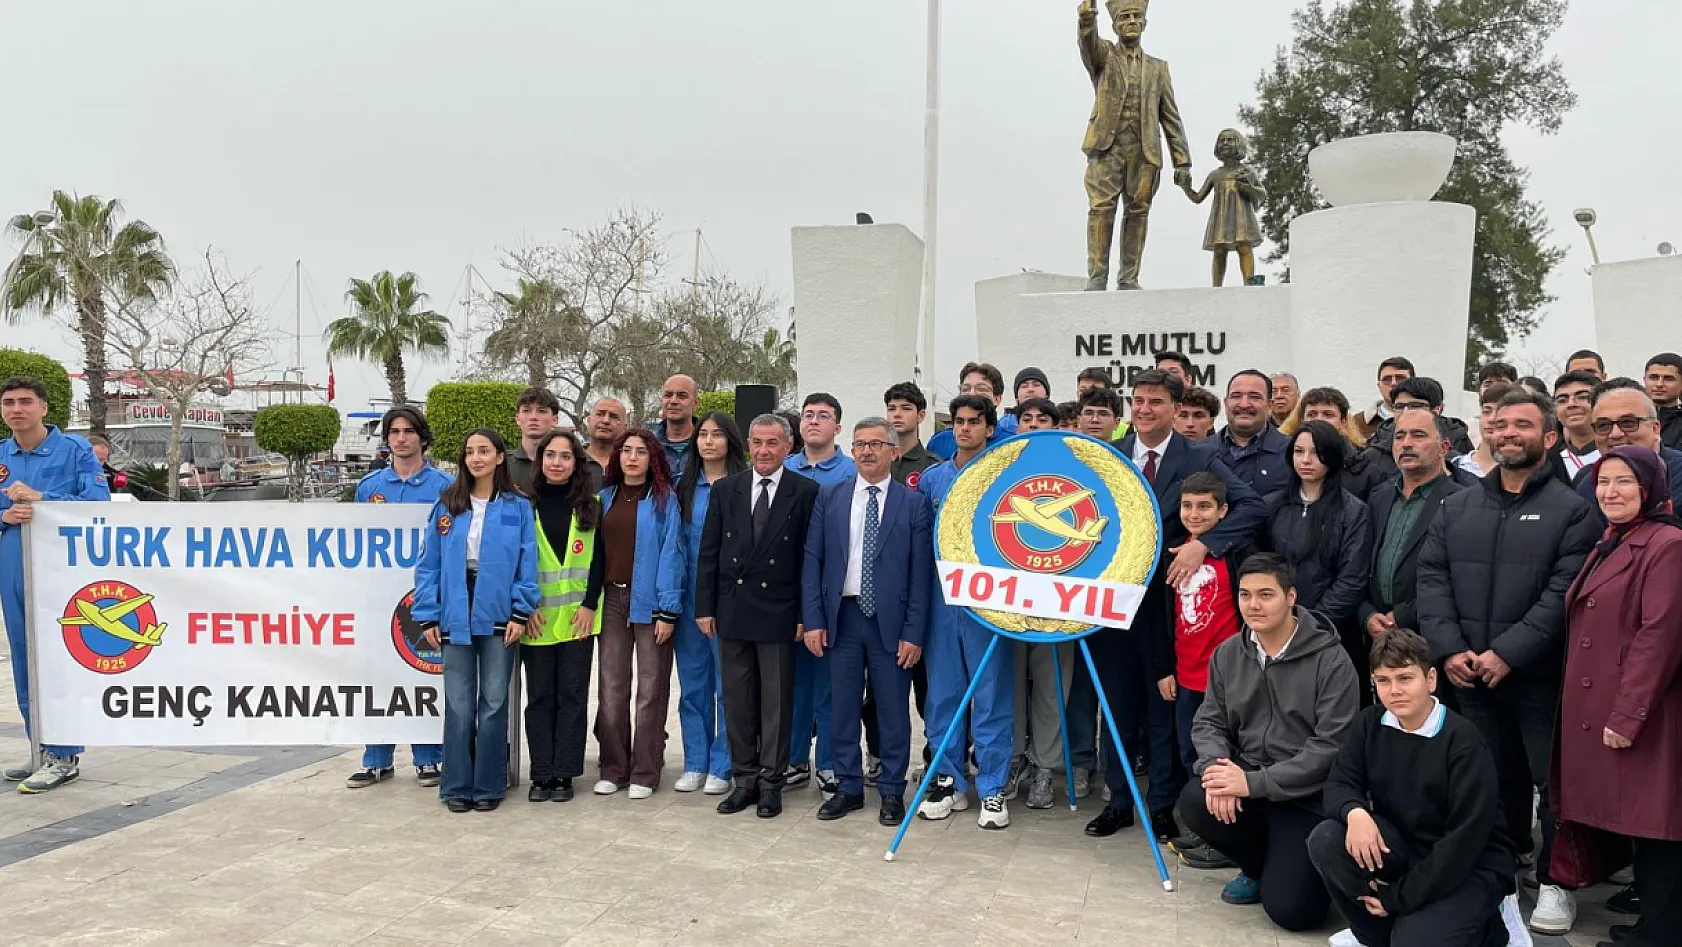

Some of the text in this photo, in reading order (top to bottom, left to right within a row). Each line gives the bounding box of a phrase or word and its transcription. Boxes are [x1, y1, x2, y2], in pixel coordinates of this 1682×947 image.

[1075, 331, 1226, 356] NE MUTLU
[181, 407, 221, 423] aptan
[58, 517, 427, 568] TÜRK HAVA KURU
[1025, 555, 1063, 568] 1925
[945, 568, 1127, 621] 101. YIL
[187, 605, 355, 646] FETHİYE
[96, 657, 127, 671] 1925
[102, 685, 440, 726] GENÇ KANATLAR
